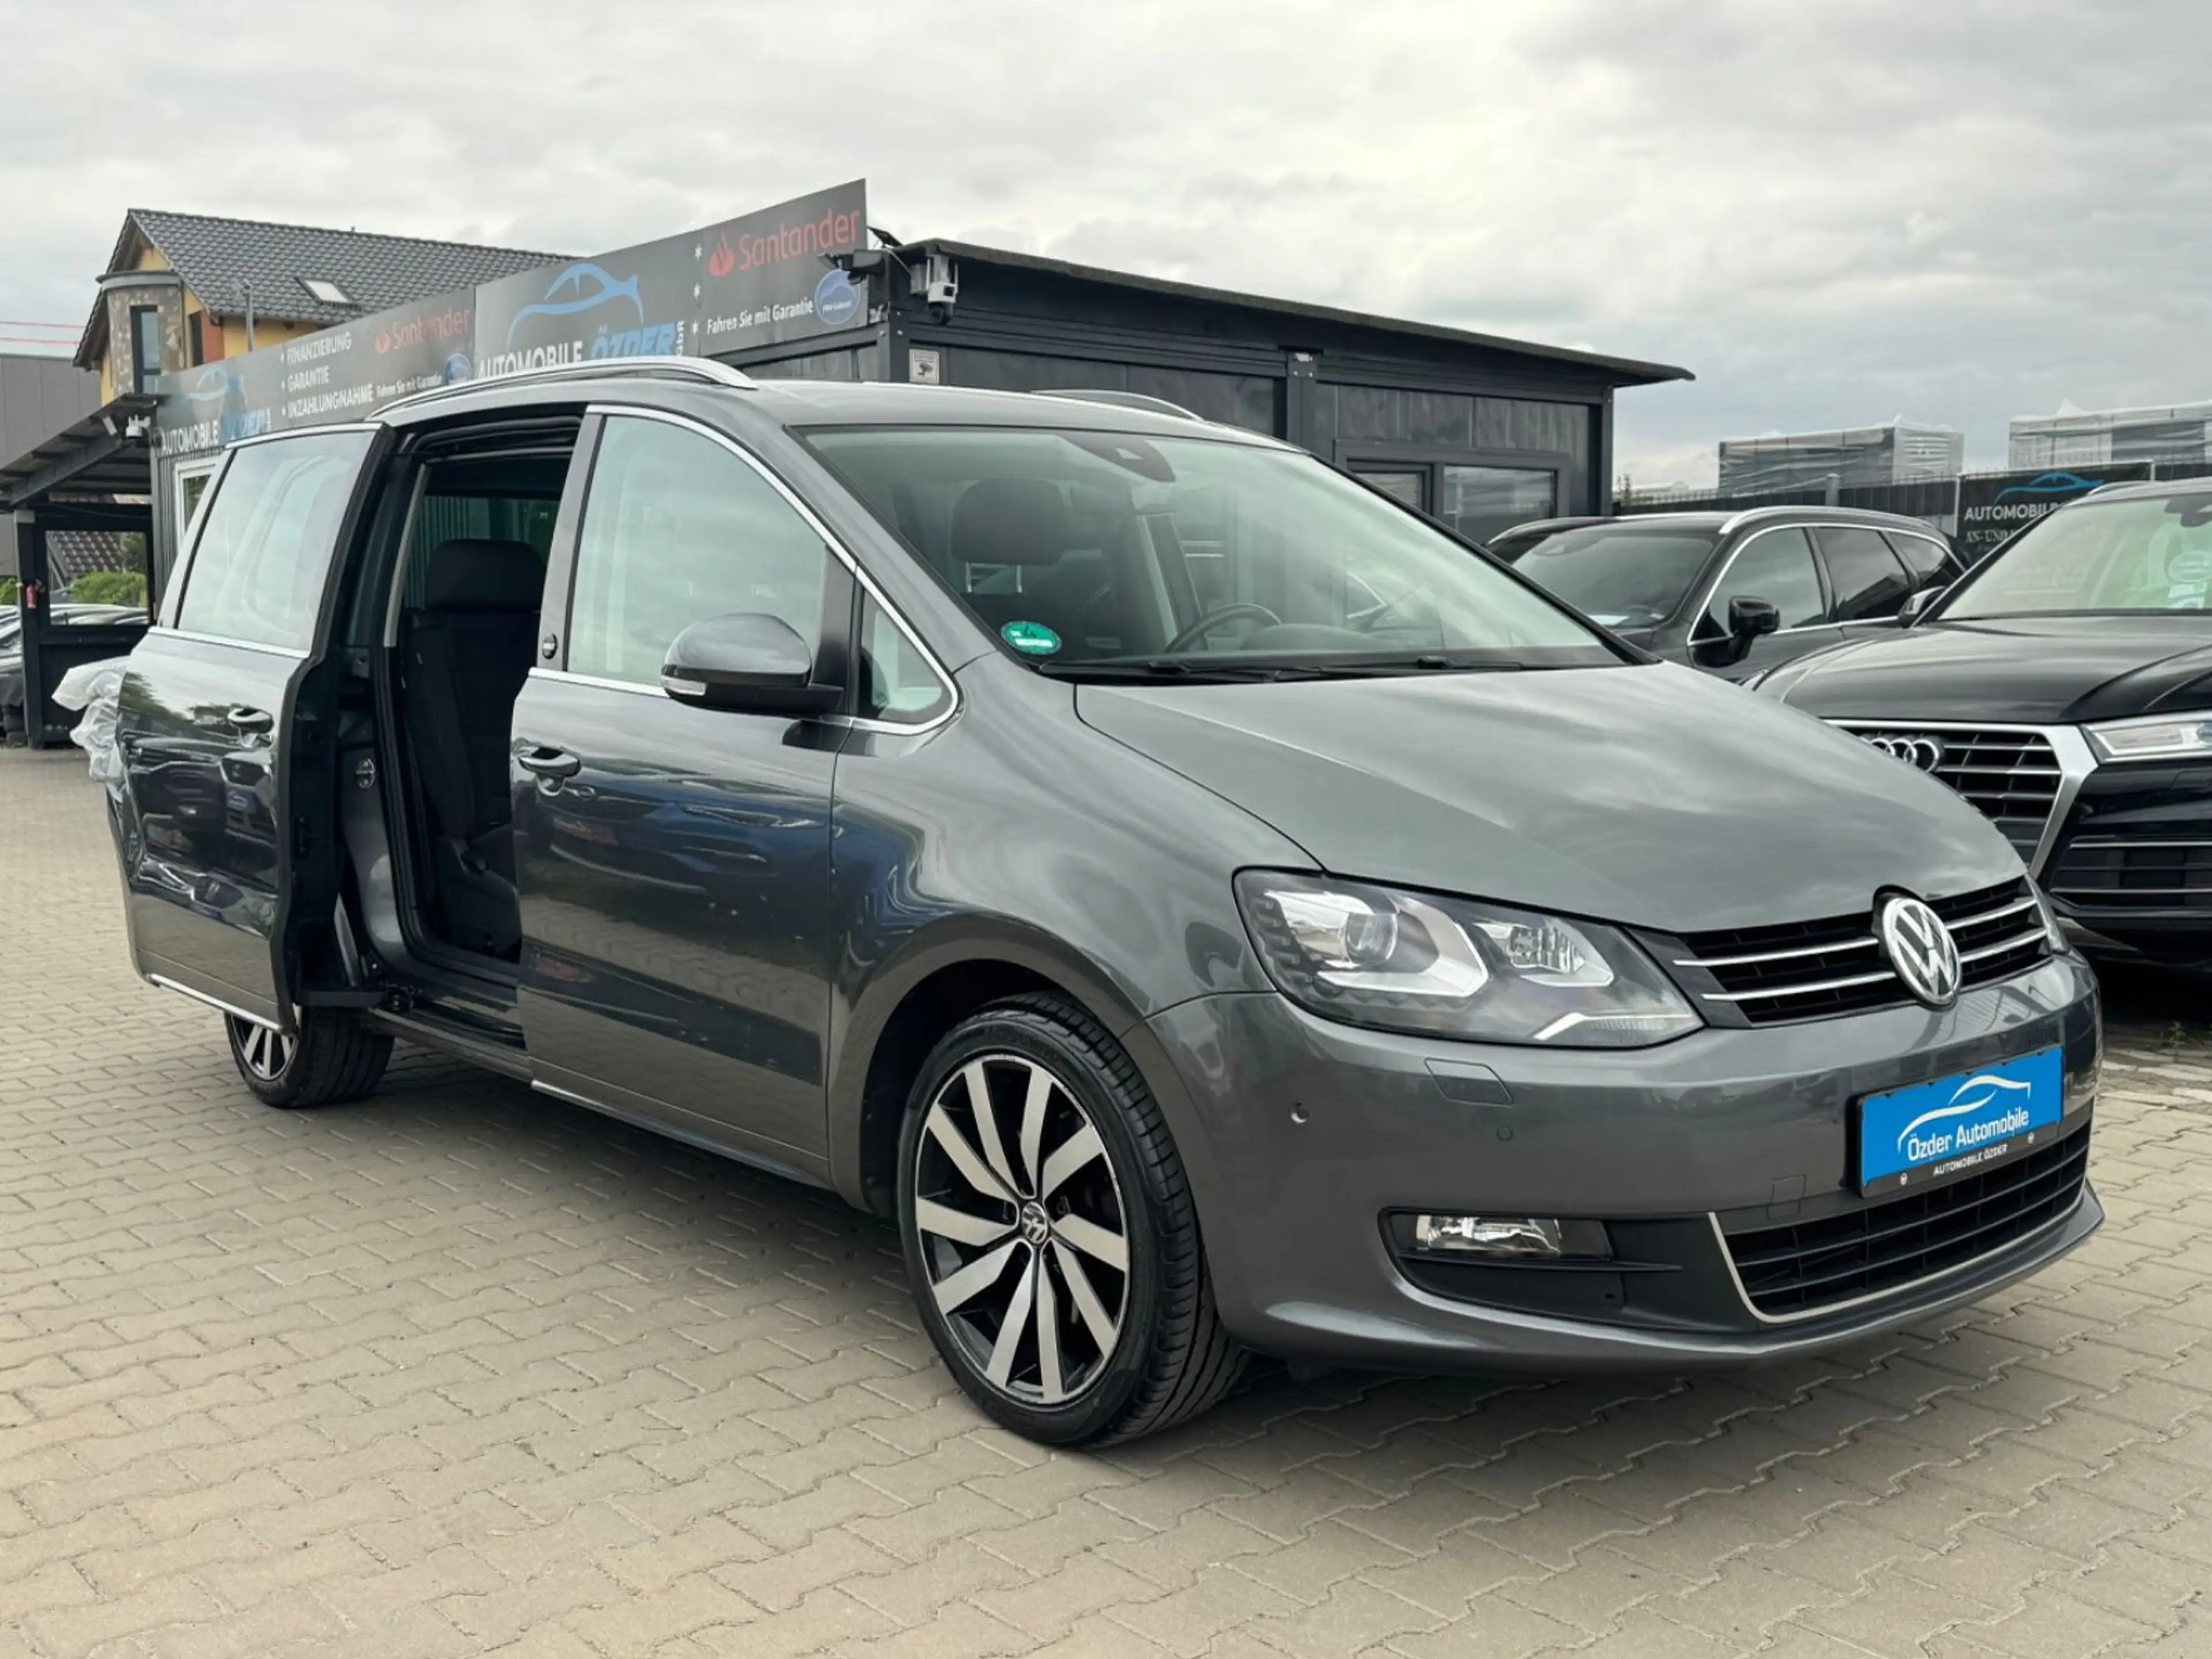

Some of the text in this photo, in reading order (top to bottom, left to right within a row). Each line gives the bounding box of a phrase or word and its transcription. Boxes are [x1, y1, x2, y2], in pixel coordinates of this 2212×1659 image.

[738, 209, 861, 272] Santander
[392, 308, 470, 350] Santnder
[707, 316, 737, 335] Fahren
[739, 309, 753, 328] Sie
[755, 305, 771, 325] mit
[772, 296, 813, 321] Garantie
[477, 340, 584, 378] AUTOMOBILE
[1908, 1106, 2029, 1161] Özder Automobile
[1933, 1154, 1982, 1175] AUTOMOBILE
